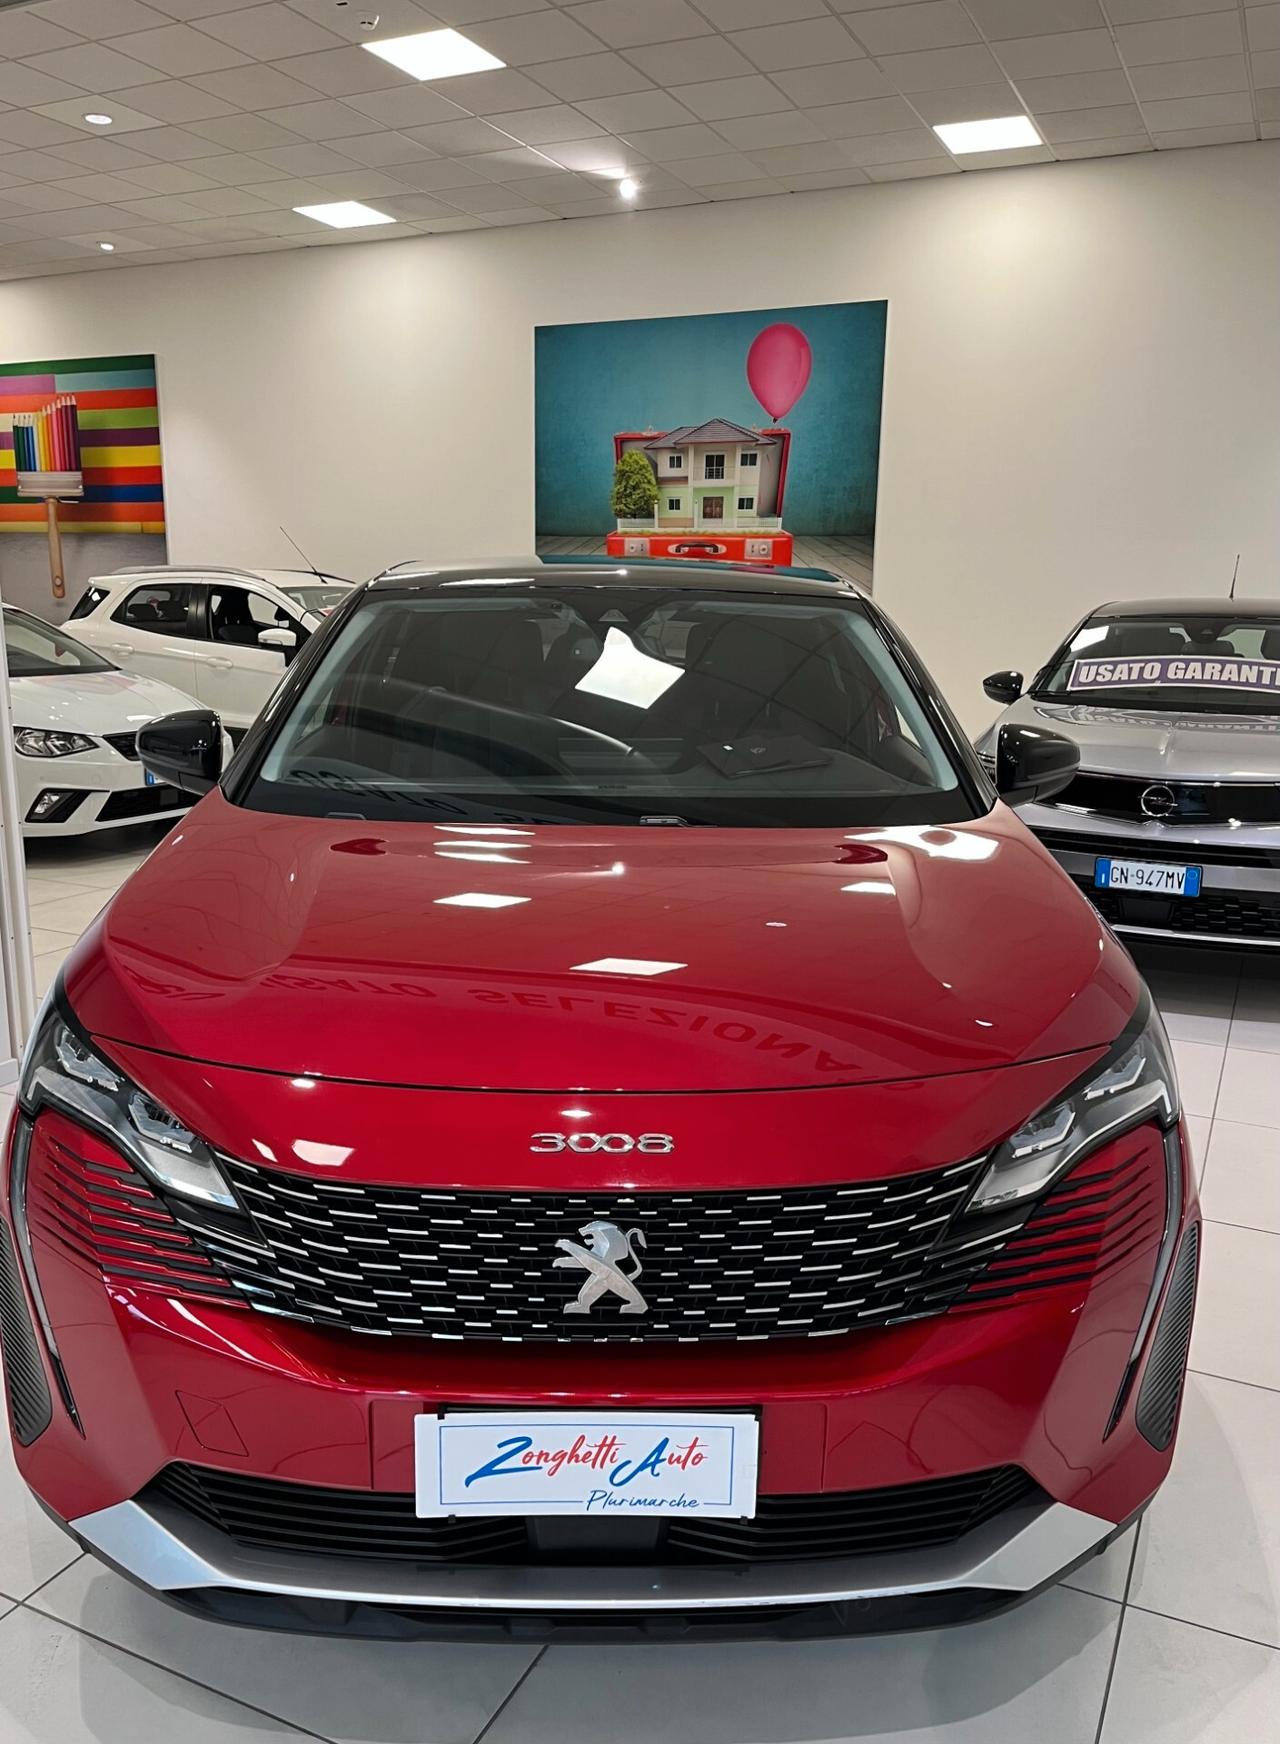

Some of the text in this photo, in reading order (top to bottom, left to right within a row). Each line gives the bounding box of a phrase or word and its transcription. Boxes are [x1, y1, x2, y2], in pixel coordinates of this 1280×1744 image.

[1078, 662, 1162, 683] USATO
[529, 1132, 675, 1153] 3008
[465, 1435, 708, 1487] Zonghetti Auto
[586, 1489, 700, 1511] Plurimarche
